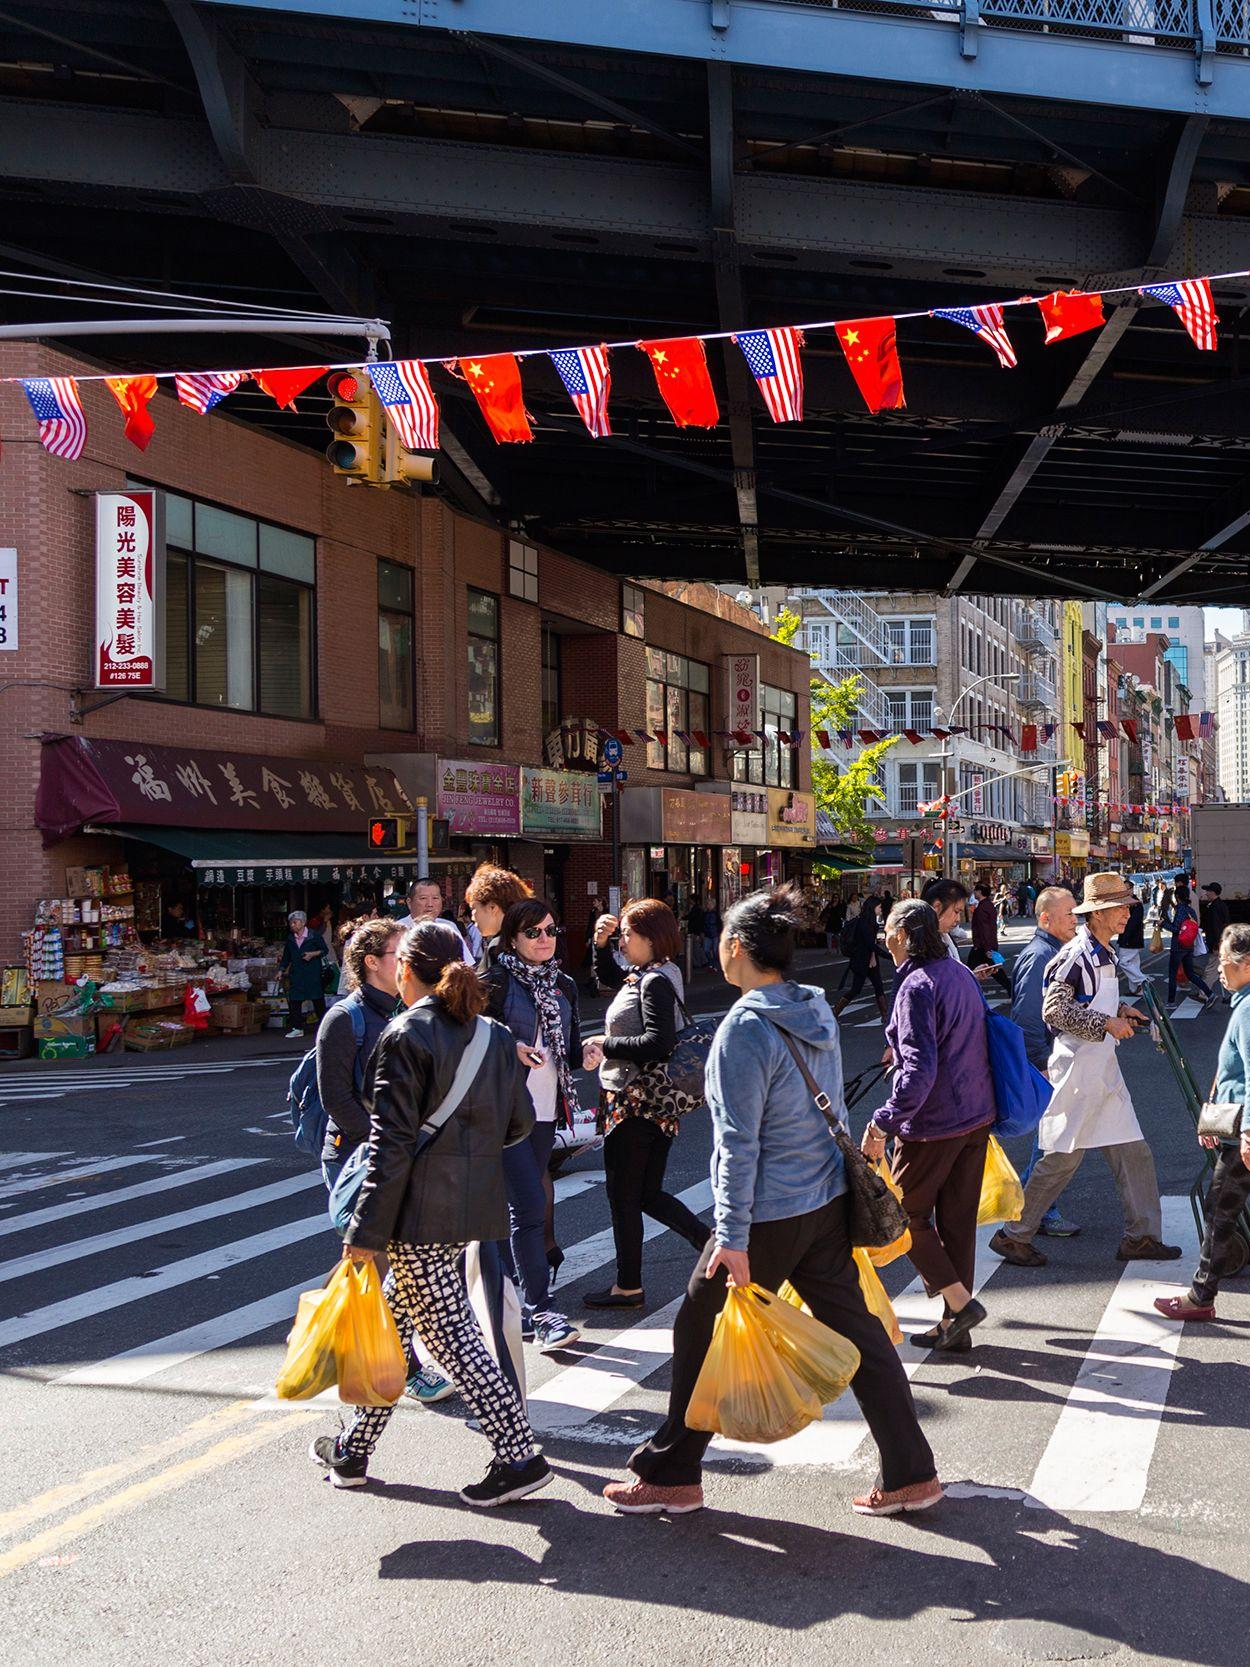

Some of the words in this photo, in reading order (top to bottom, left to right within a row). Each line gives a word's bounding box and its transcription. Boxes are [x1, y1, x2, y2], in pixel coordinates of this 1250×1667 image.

[116, 505, 136, 656] 陽光美容美髮
[128, 672, 141, 680] 75E
